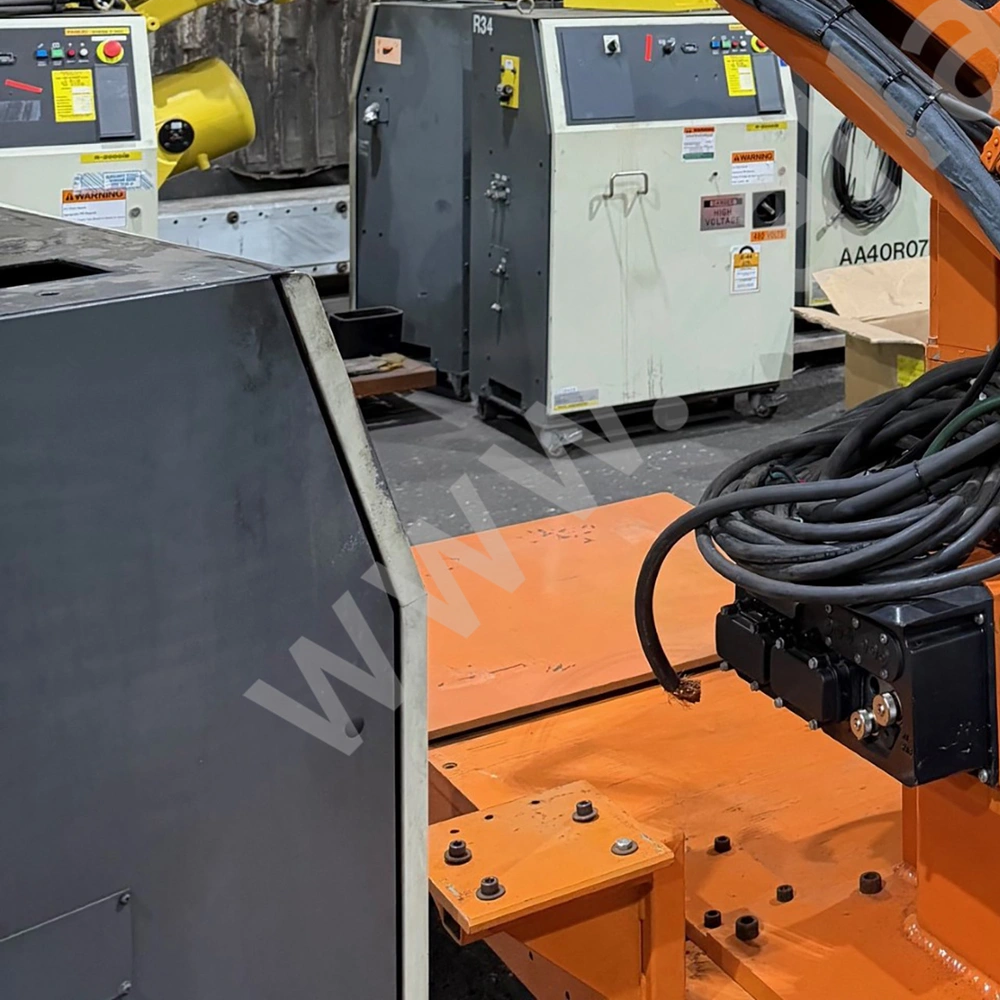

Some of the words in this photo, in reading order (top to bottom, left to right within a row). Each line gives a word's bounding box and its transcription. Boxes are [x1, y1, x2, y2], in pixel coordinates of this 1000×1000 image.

[472, 14, 493, 36] R34
[74, 190, 124, 201] WARNING
[713, 209, 732, 217] HIGH
[705, 216, 740, 226] VOLTAGE
[839, 239, 929, 267] AA40R07
